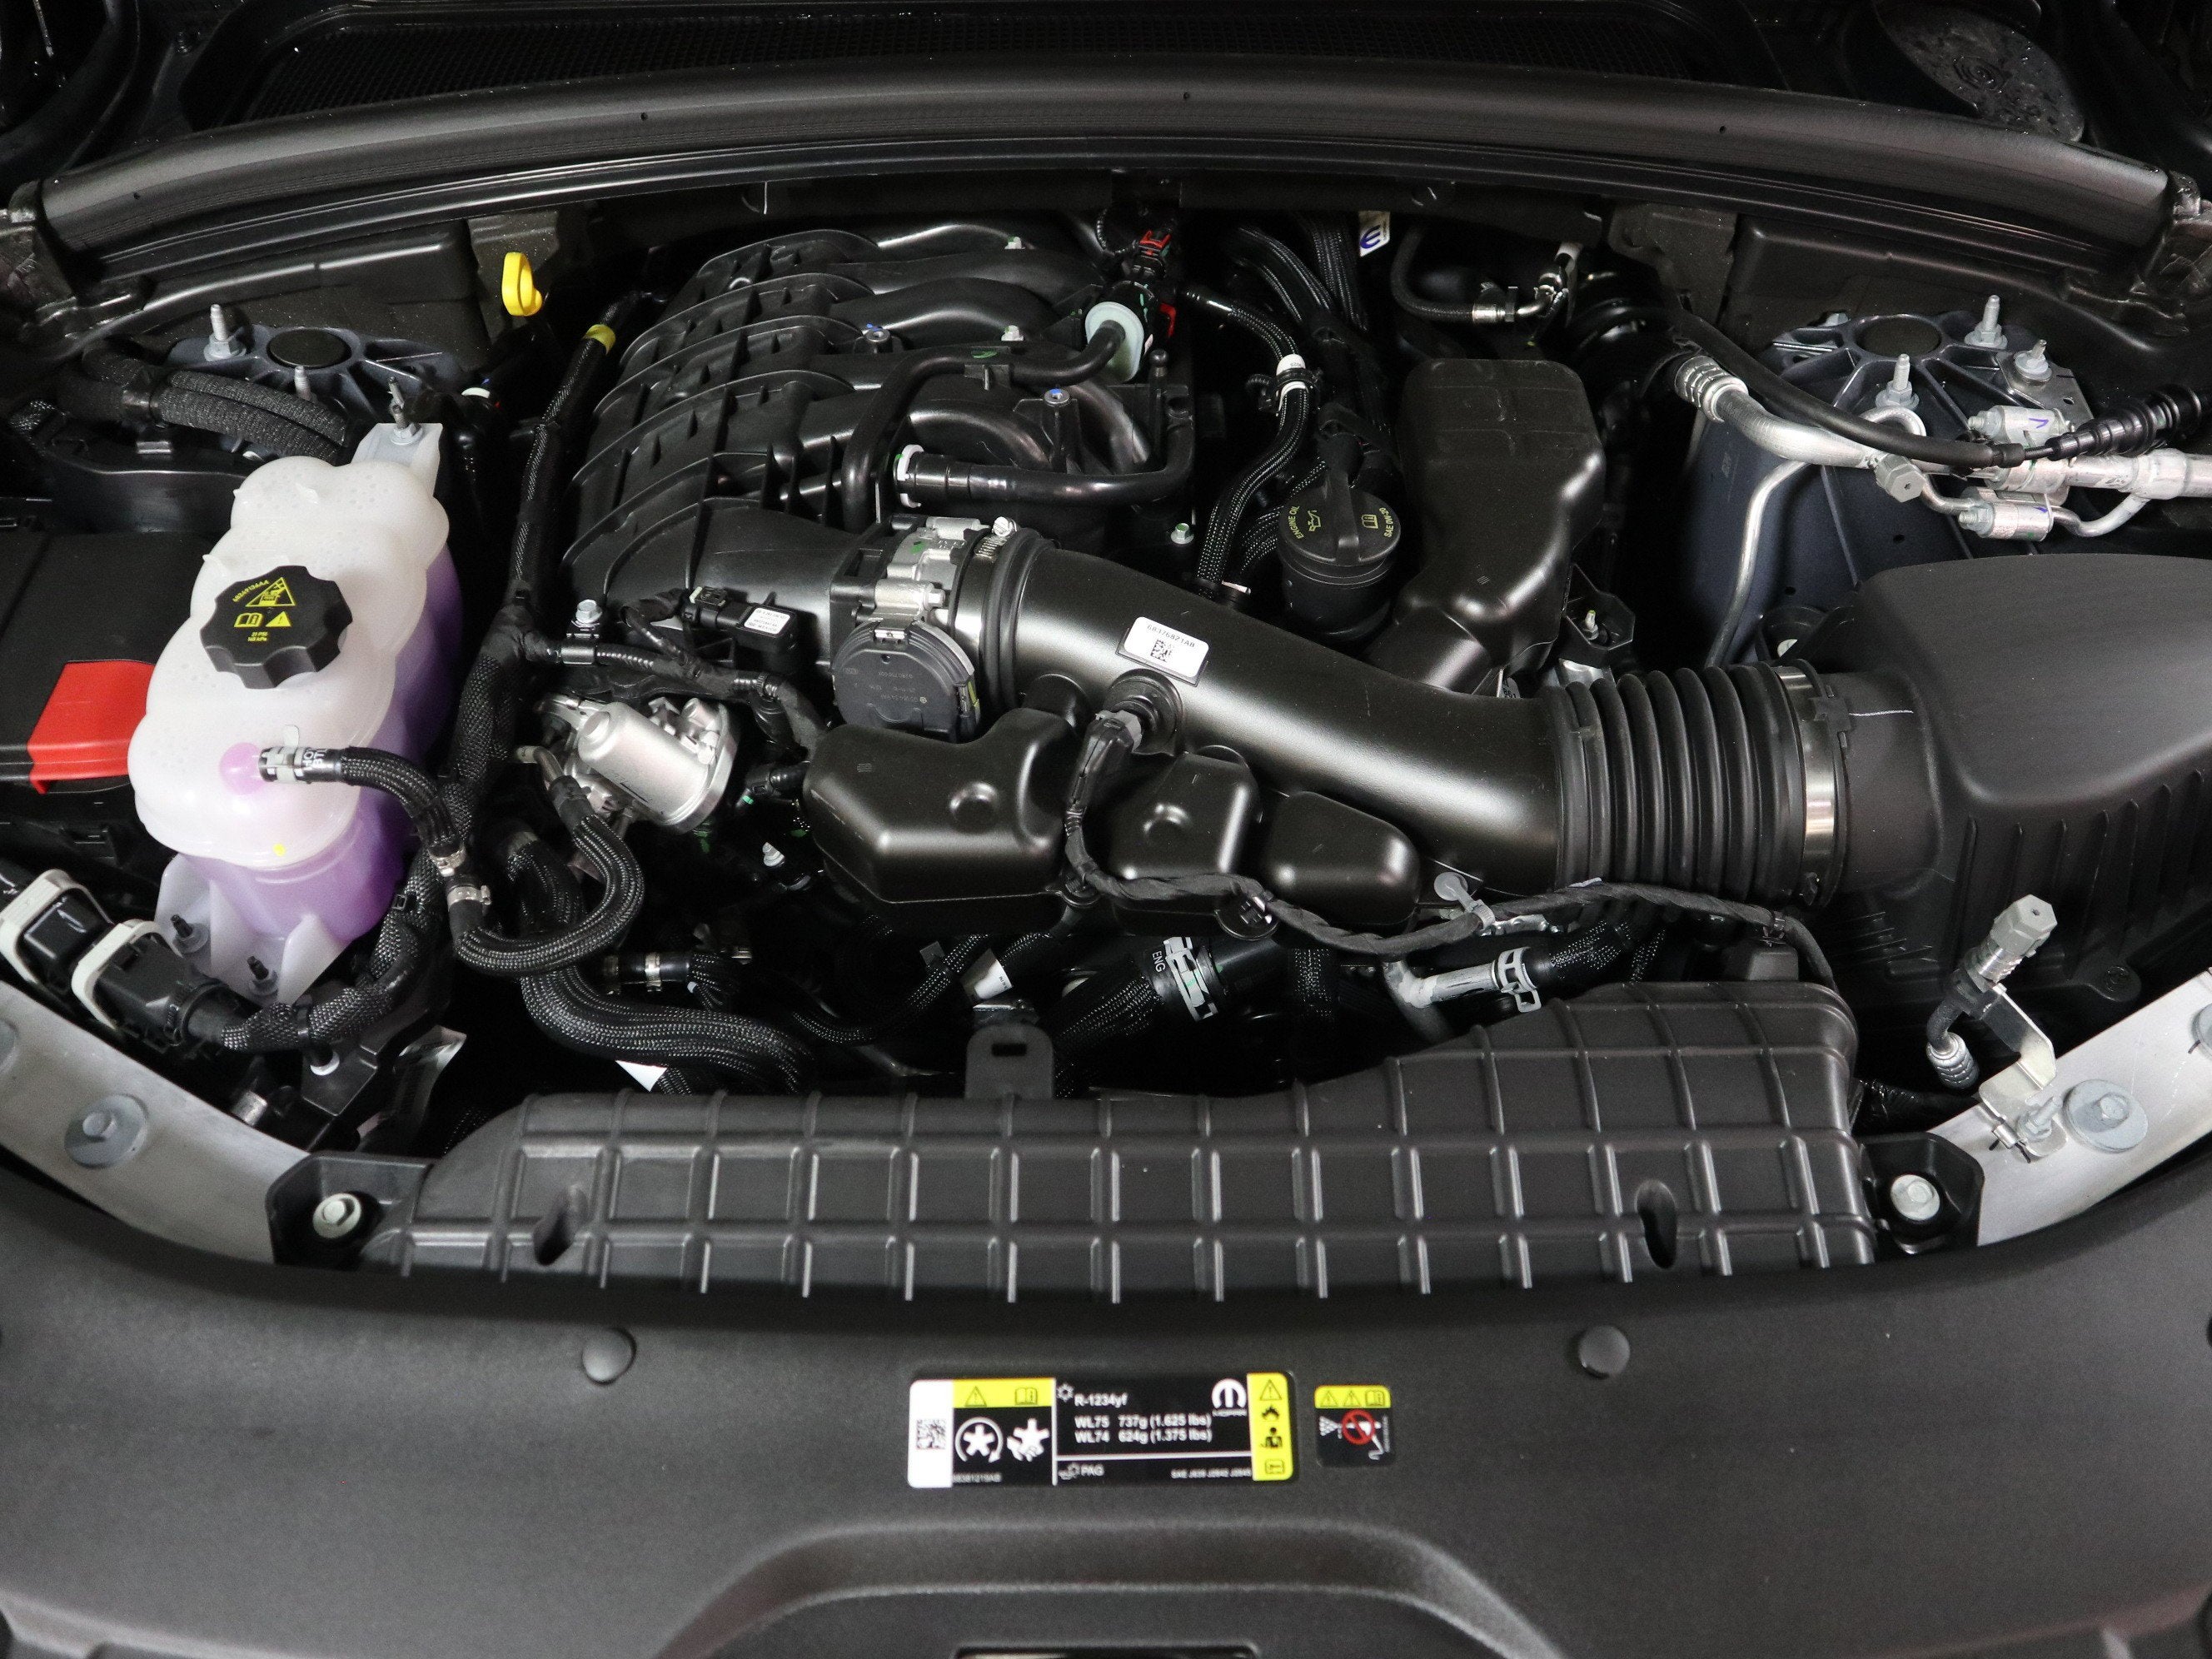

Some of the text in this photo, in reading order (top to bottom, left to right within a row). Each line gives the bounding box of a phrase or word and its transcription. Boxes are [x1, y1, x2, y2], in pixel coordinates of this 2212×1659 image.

[1288, 506, 1305, 540] ENGINE OIL
[1378, 507, 1394, 538] SAE 0W-20
[1147, 624, 1195, 648] 68376821AB
[1152, 950, 1166, 973] ENG
[1074, 1392, 1128, 1407] R-1234yf
[1074, 1413, 1212, 1430] WL75 737g (1.625 lbs)
[1074, 1427, 1213, 1445] WL74 624g (1.375 lbs)
[1080, 1463, 1105, 1477] PAG
